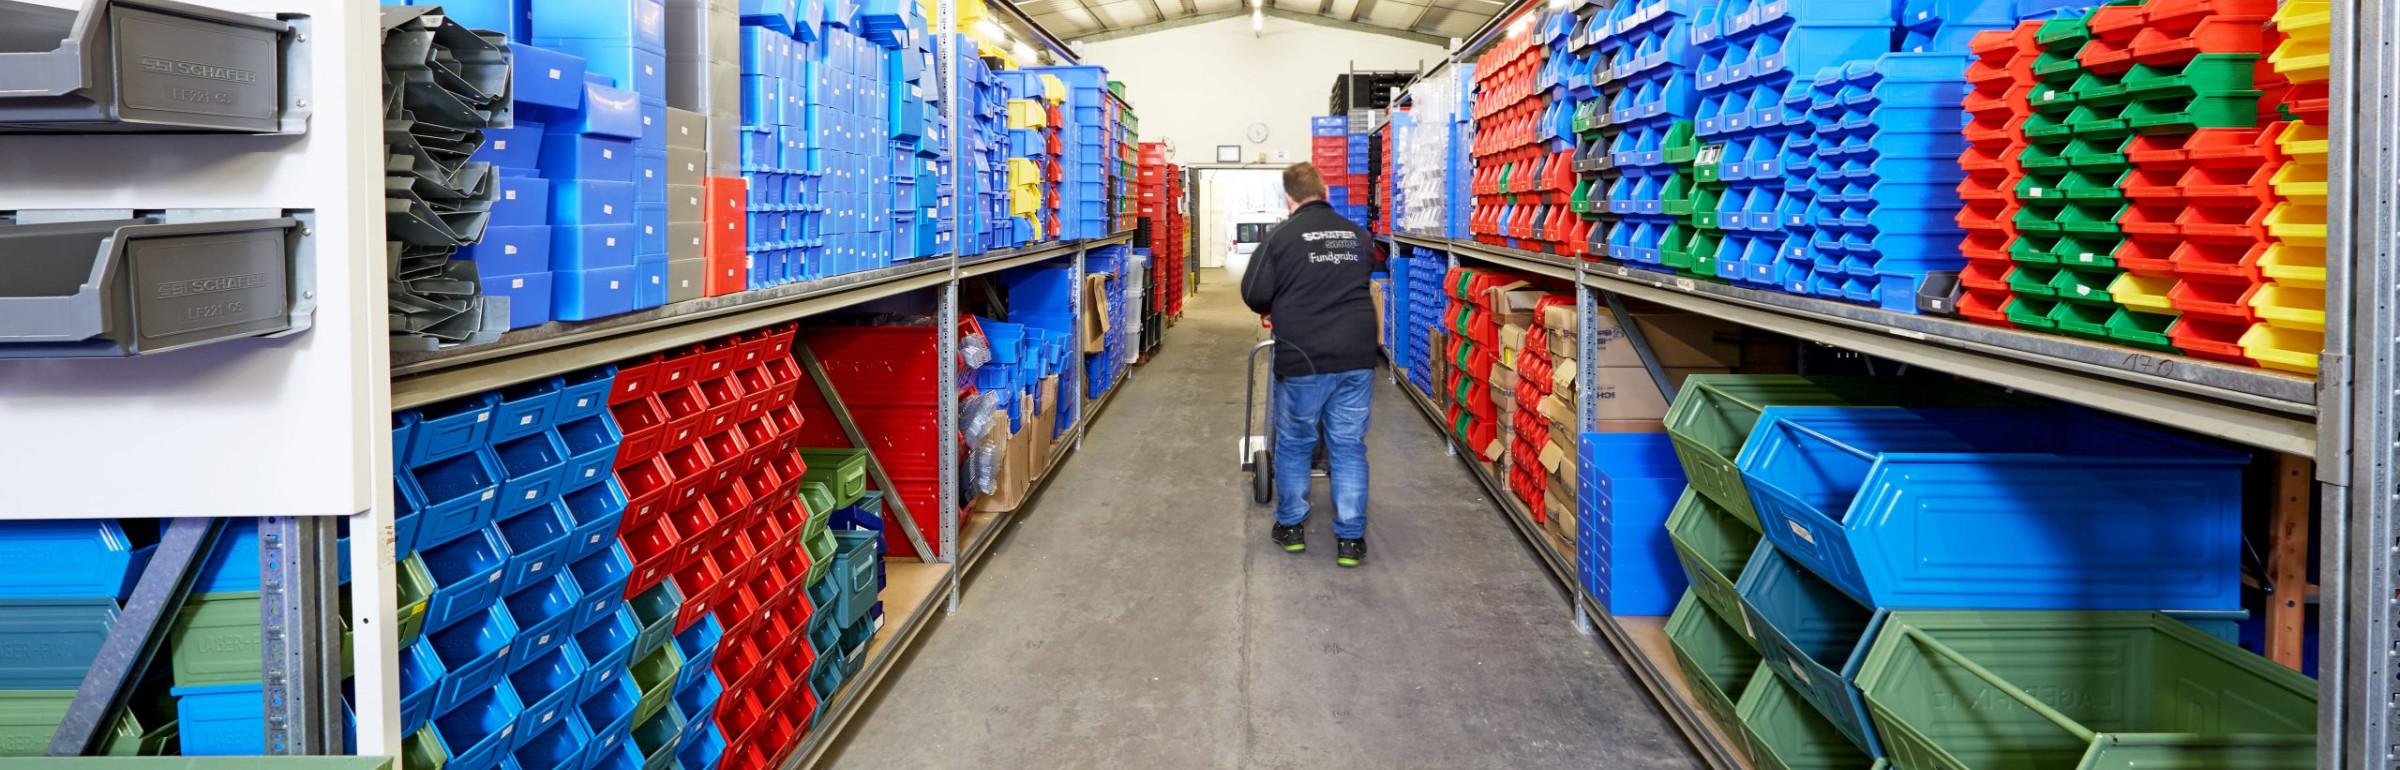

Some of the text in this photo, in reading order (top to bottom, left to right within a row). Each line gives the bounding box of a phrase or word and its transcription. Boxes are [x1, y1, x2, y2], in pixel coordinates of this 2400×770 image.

[142, 57, 173, 72] SSI
[173, 88, 209, 102] LF221
[1308, 251, 1358, 264] Fundgrube
[158, 281, 188, 296] SSI
[2122, 353, 2174, 377] 170
